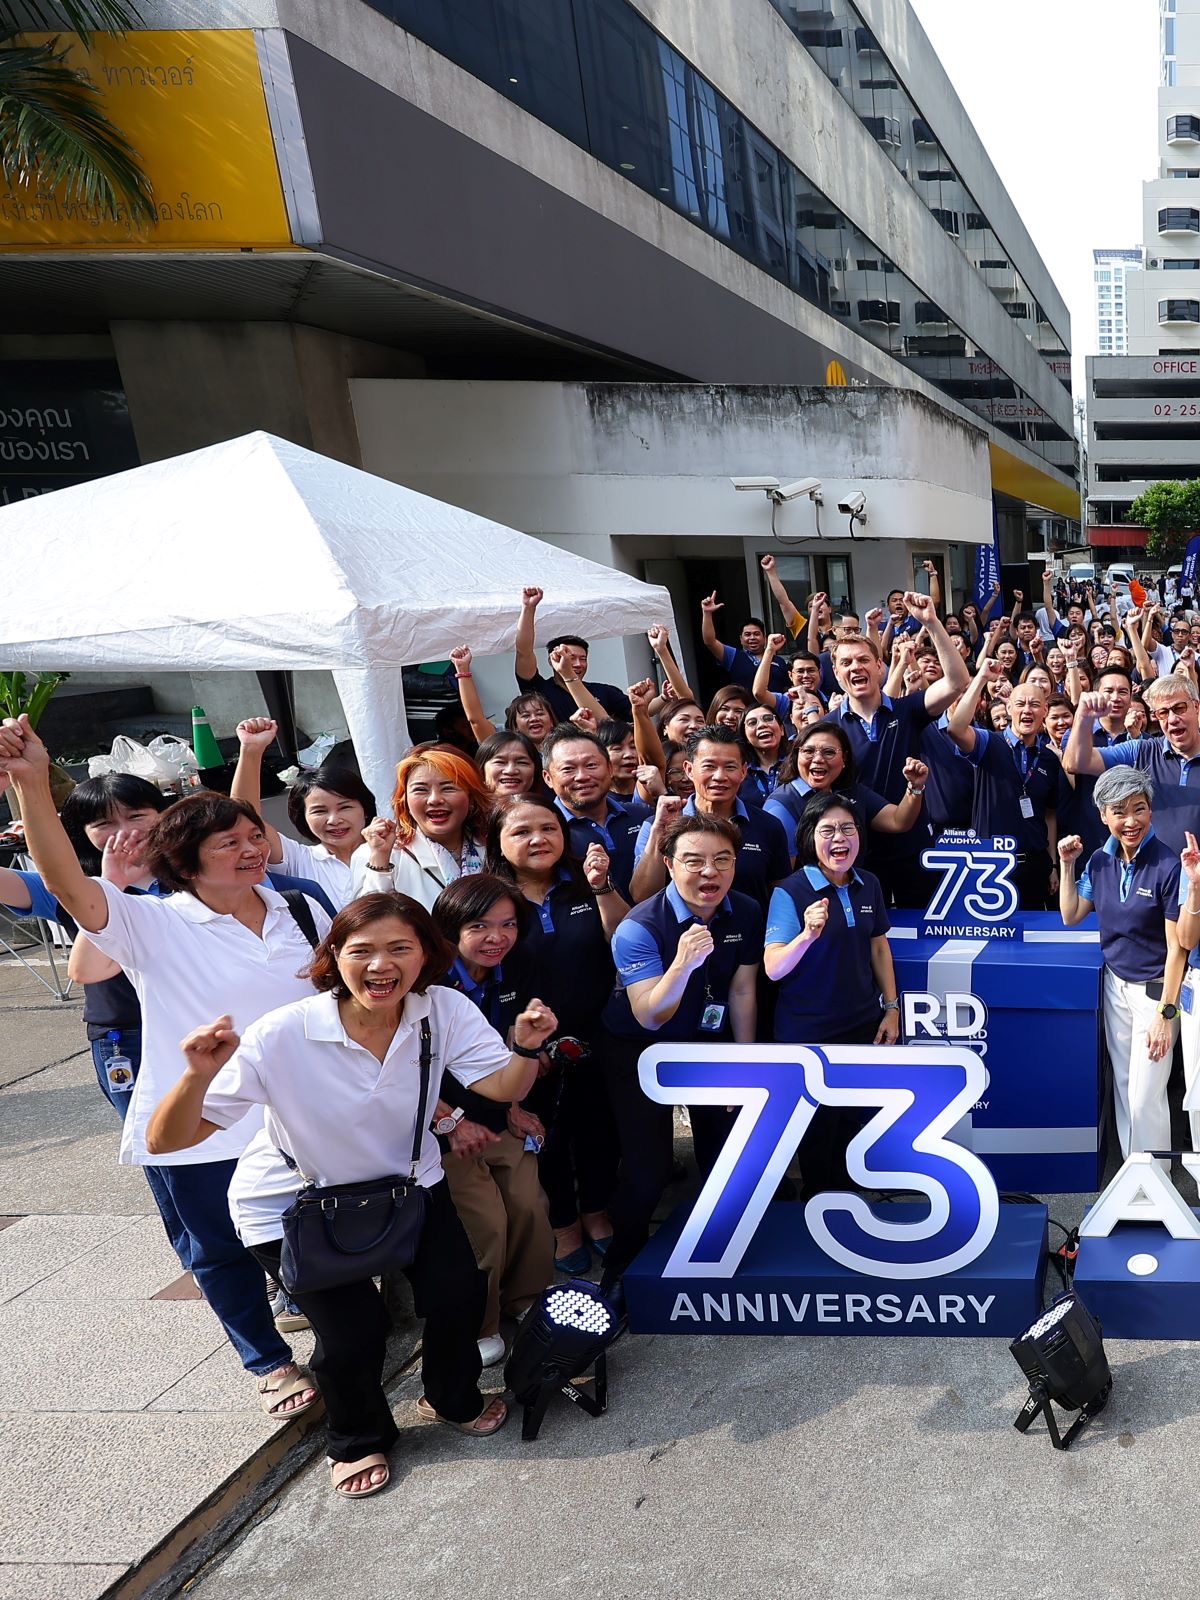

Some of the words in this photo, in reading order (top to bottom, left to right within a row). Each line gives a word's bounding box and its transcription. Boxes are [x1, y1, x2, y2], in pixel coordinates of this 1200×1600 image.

[1153, 361, 1197, 373] OFFICE
[922, 851, 1018, 921] 73
[993, 838, 1016, 851] RD
[925, 926, 1016, 938] ANNIVERSARY
[904, 993, 986, 1037] RD
[637, 1041, 1000, 1280] 73
[669, 1292, 996, 1323] ANNIVERSARY
